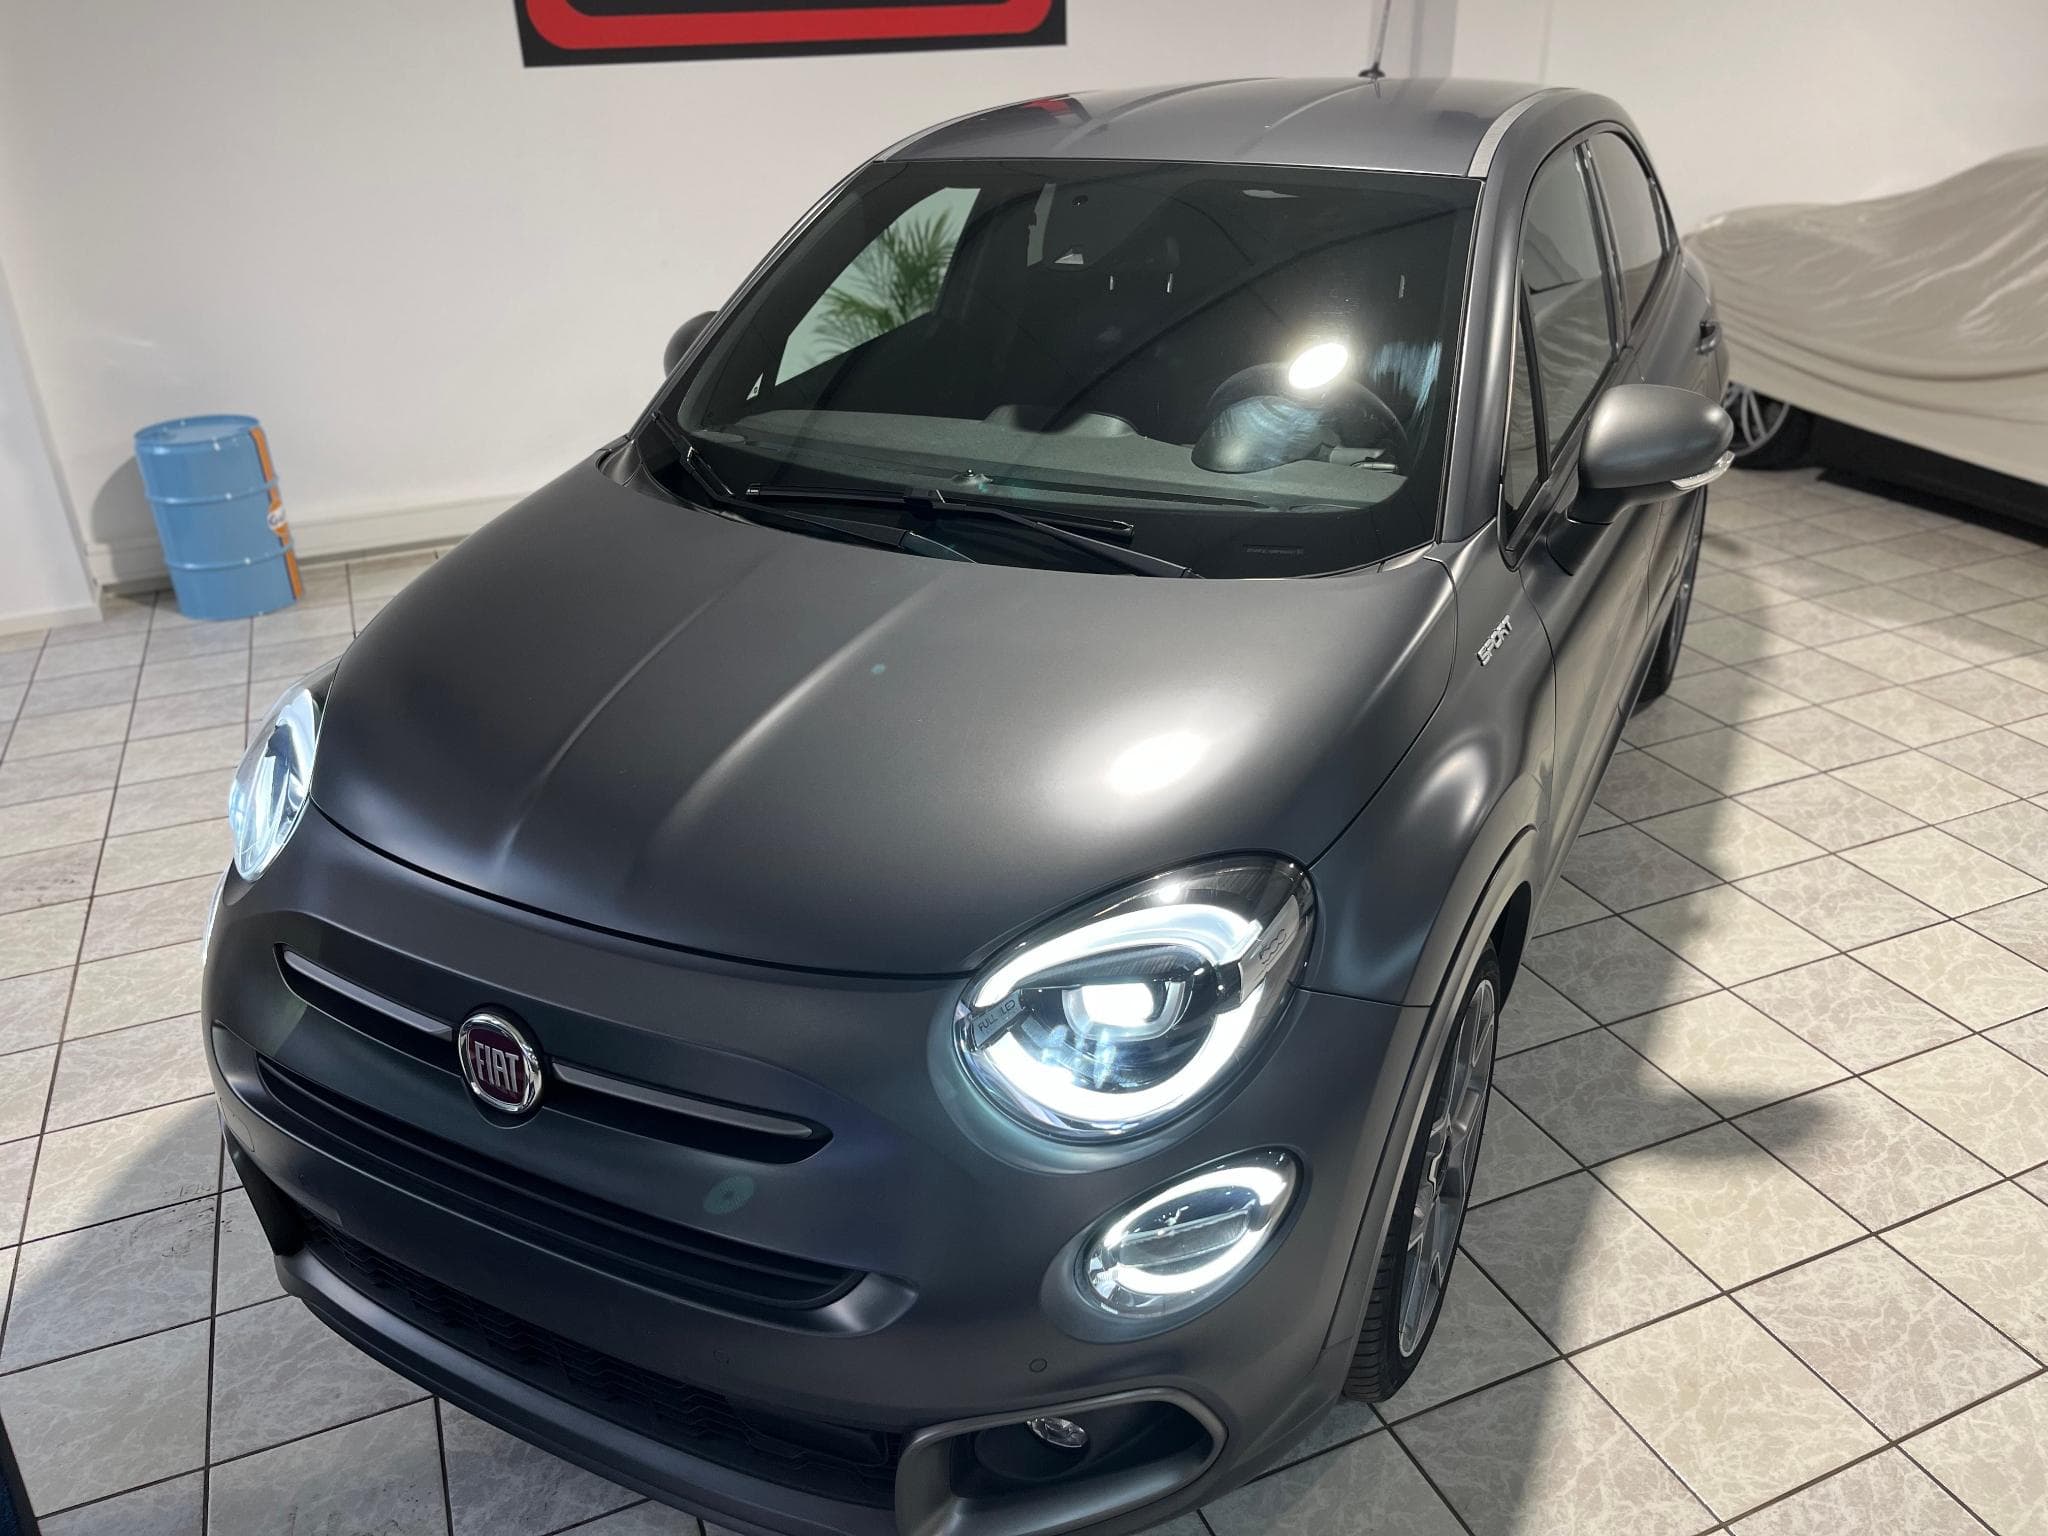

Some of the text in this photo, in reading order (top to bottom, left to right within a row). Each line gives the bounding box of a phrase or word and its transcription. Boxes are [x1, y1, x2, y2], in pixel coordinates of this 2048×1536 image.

[1477, 614, 1513, 667] SPORT
[978, 1013, 999, 1033] FULL
[474, 1040, 520, 1094] FIAT
